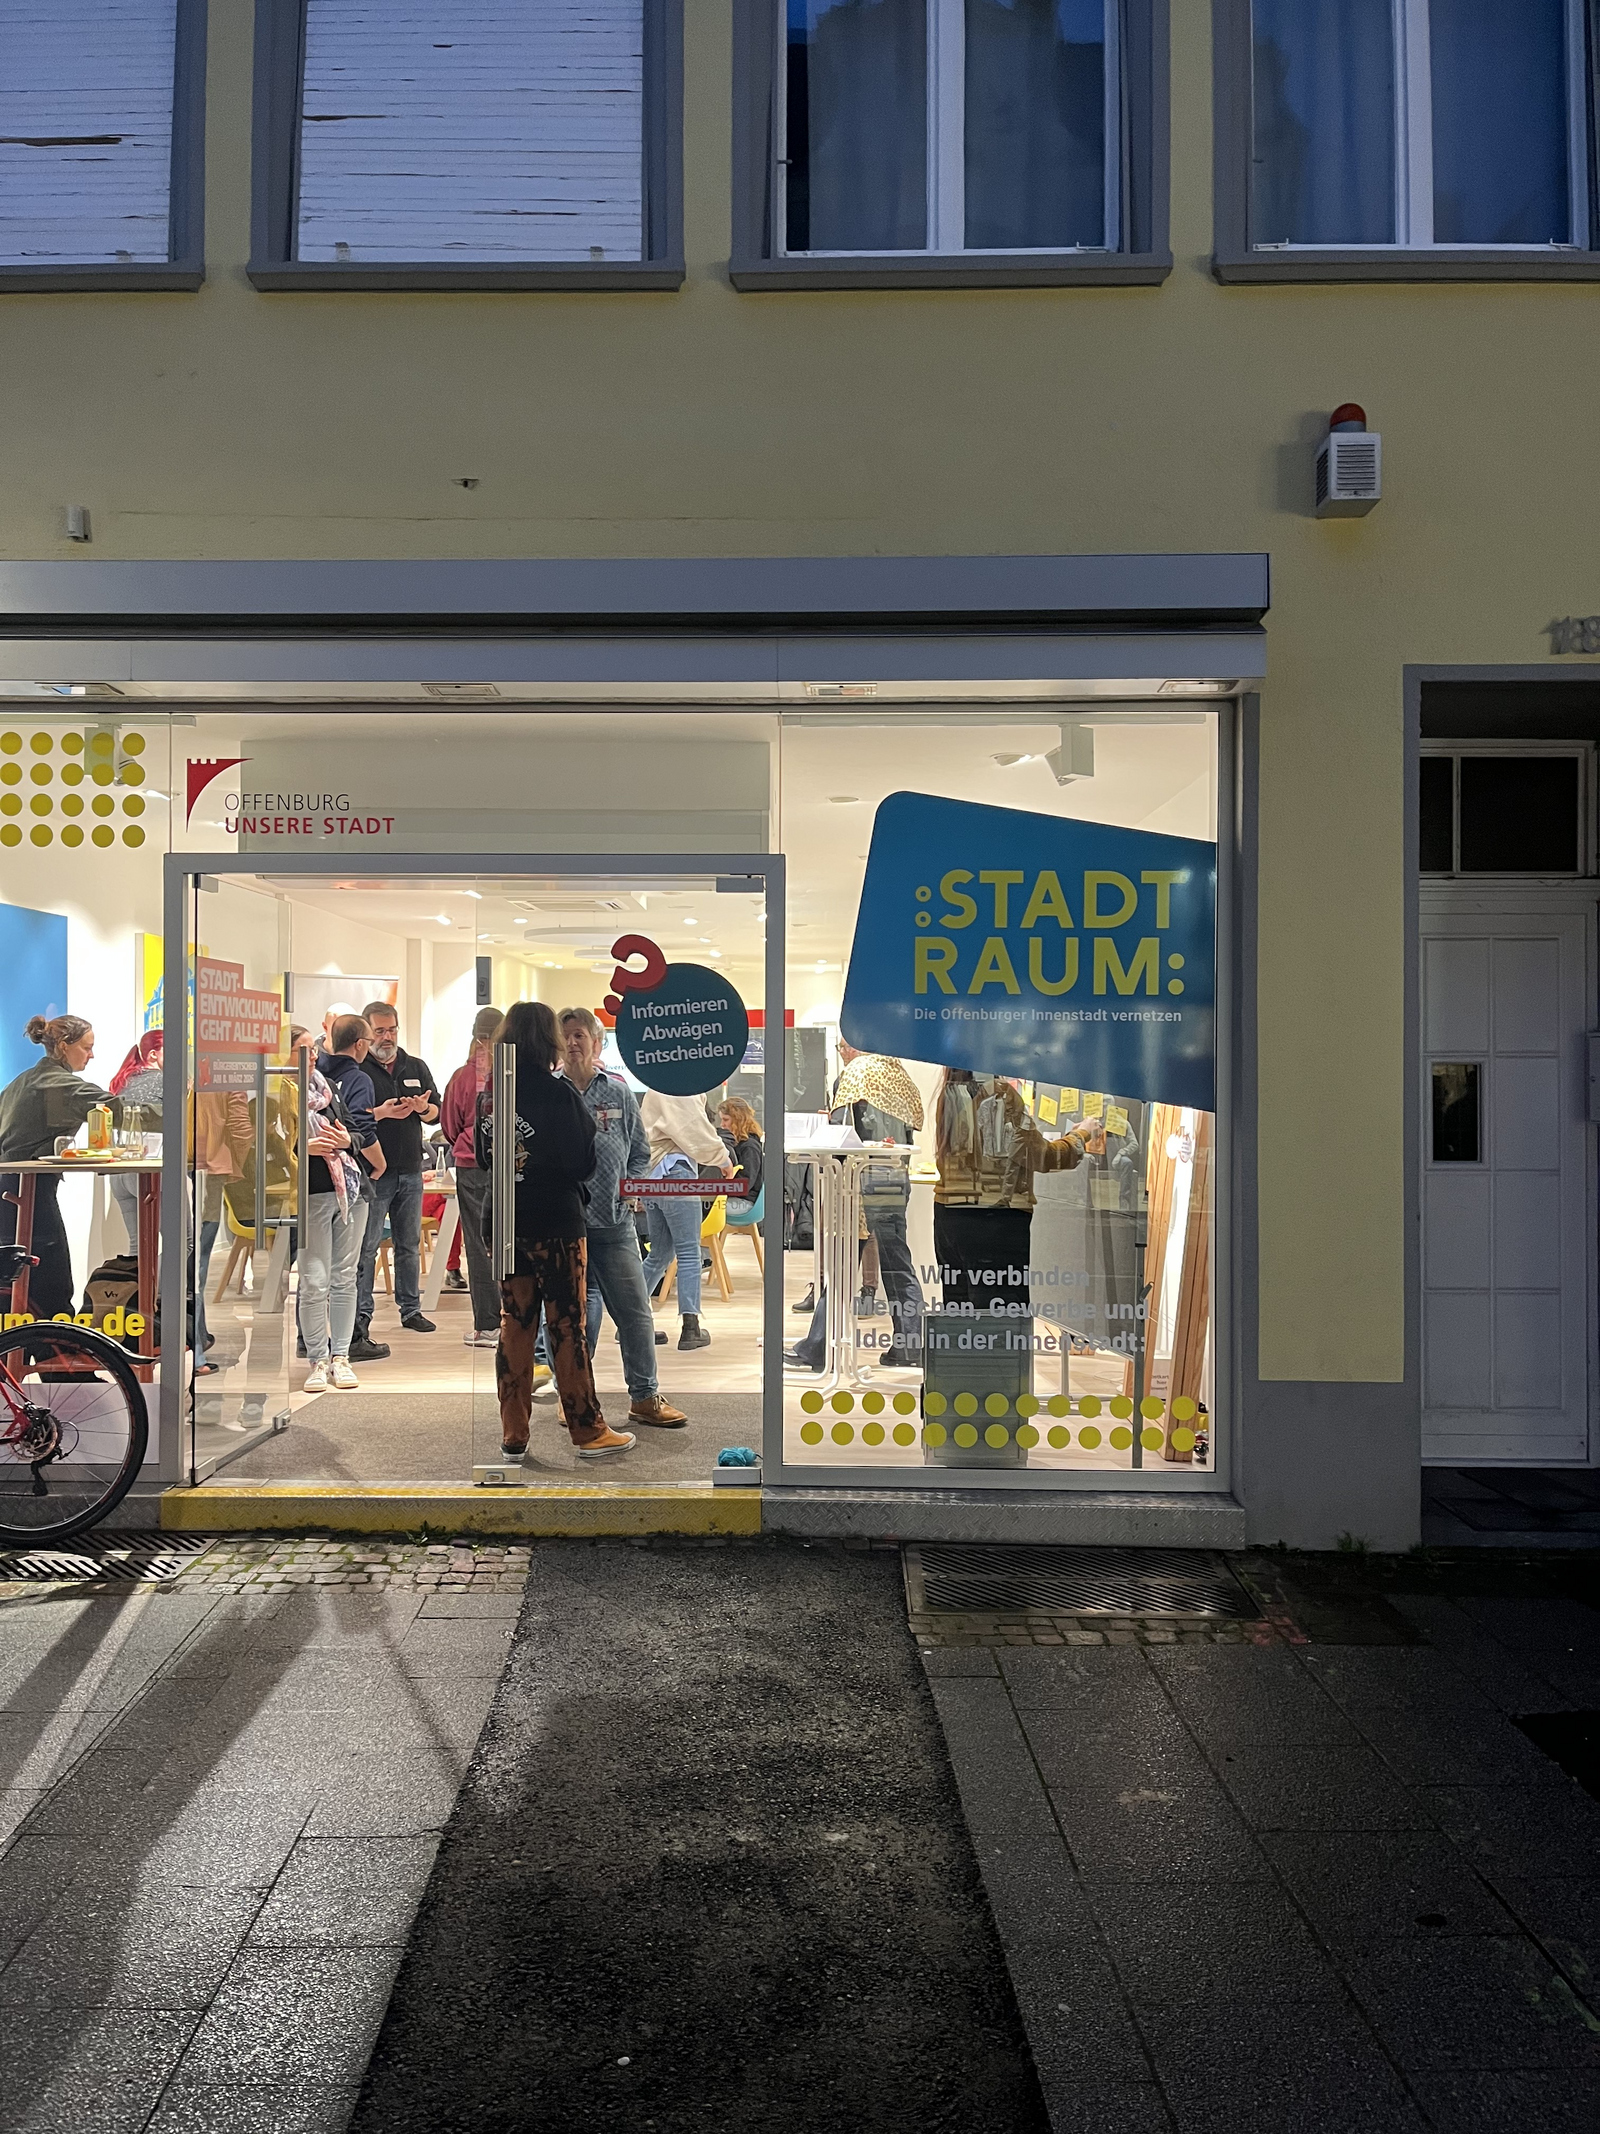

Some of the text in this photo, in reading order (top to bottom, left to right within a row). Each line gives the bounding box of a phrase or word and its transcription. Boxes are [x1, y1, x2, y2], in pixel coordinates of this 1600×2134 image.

[225, 793, 350, 811] OFFENBURG
[225, 817, 395, 834] UNSERE STADT
[914, 936, 1186, 996] RAUM:
[200, 967, 241, 993] STADT-
[200, 993, 279, 1021] ENTWICKLUNG
[631, 996, 728, 1020] Informieren
[914, 1007, 1182, 1023] Die Offenburger Innenstadt vernetzen
[200, 1018, 277, 1044] GEHT ALLE AN
[642, 1021, 723, 1042] Abwägen
[635, 1042, 734, 1065] Entscheiden
[624, 1180, 744, 1193] ÖFFNUNGSZEITEN
[920, 1264, 1090, 1286] Wir verbinden
[853, 1296, 1148, 1321] Menschen, Gewerbe und
[856, 1327, 923, 1349] Ideen
[929, 1328, 950, 1350] in
[957, 1328, 998, 1350] der
